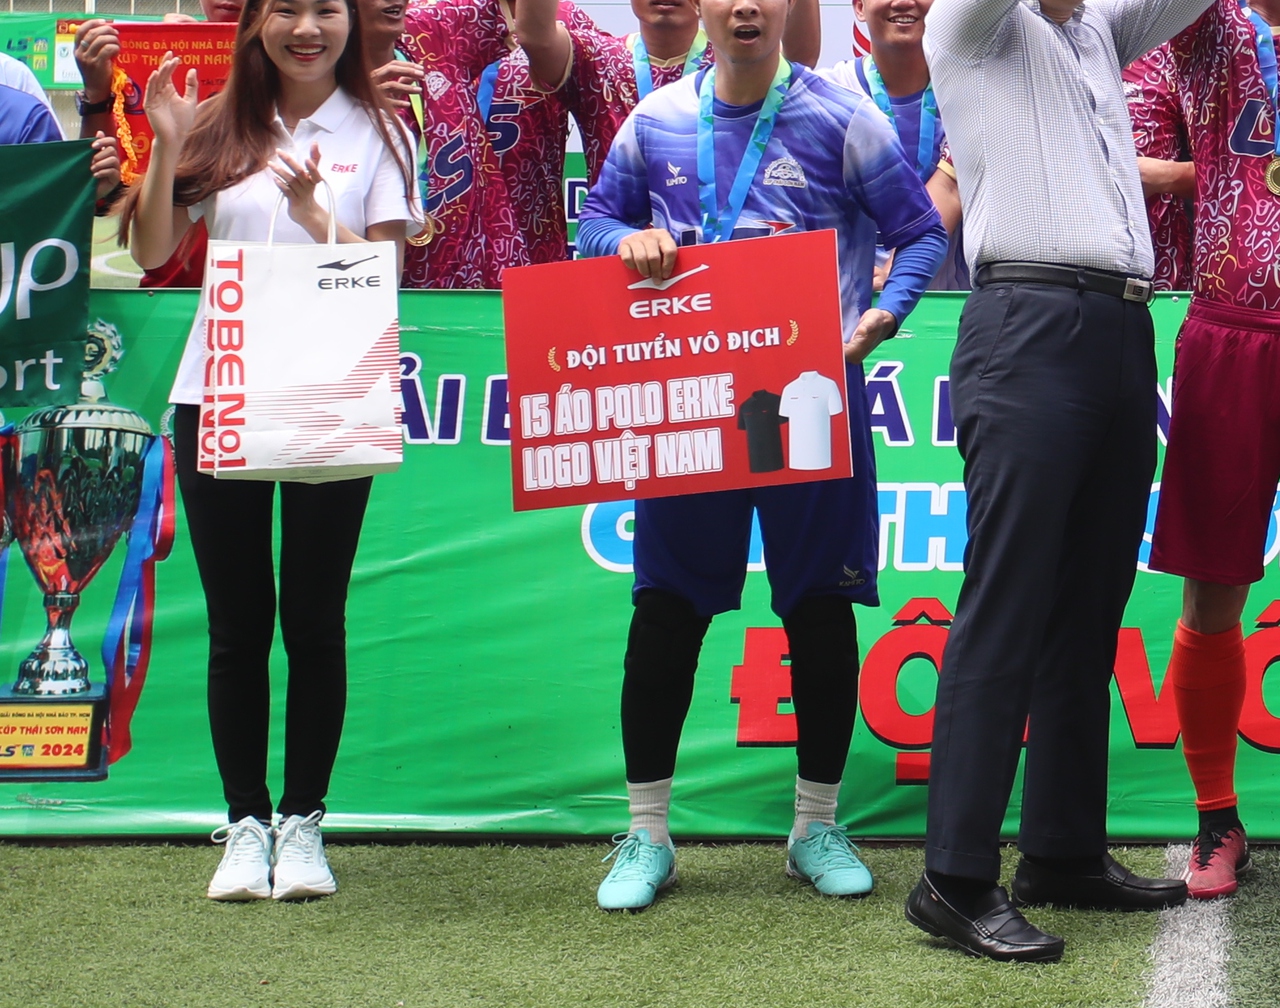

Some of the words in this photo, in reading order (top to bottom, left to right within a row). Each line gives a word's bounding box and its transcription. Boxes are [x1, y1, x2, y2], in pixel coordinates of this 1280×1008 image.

[153, 39, 168, 50] ĐÁ
[170, 40, 189, 52] HỘI
[191, 38, 213, 50] NHÀ
[486, 102, 521, 154] S
[331, 163, 359, 174] ERKE
[317, 275, 382, 291] ERKE
[628, 293, 712, 320] ERKE
[566, 343, 607, 372] ĐỘI
[612, 332, 682, 364] TUYỂN
[687, 330, 721, 355] VÔ
[726, 327, 781, 354] ĐỊCH
[400, 352, 466, 445] ẢI
[865, 361, 914, 447] Á
[520, 393, 550, 439] 15
[555, 383, 592, 436] ÁO
[596, 381, 665, 431] POLO
[666, 372, 736, 423] ERKE
[522, 442, 592, 492] LOGO
[593, 429, 651, 490] VIỆT
[655, 427, 725, 479] NAM
[20, 724, 43, 735] THÁI
[45, 725, 65, 735] SƠN
[66, 725, 89, 736] NAM
[40, 743, 85, 757] 2024
